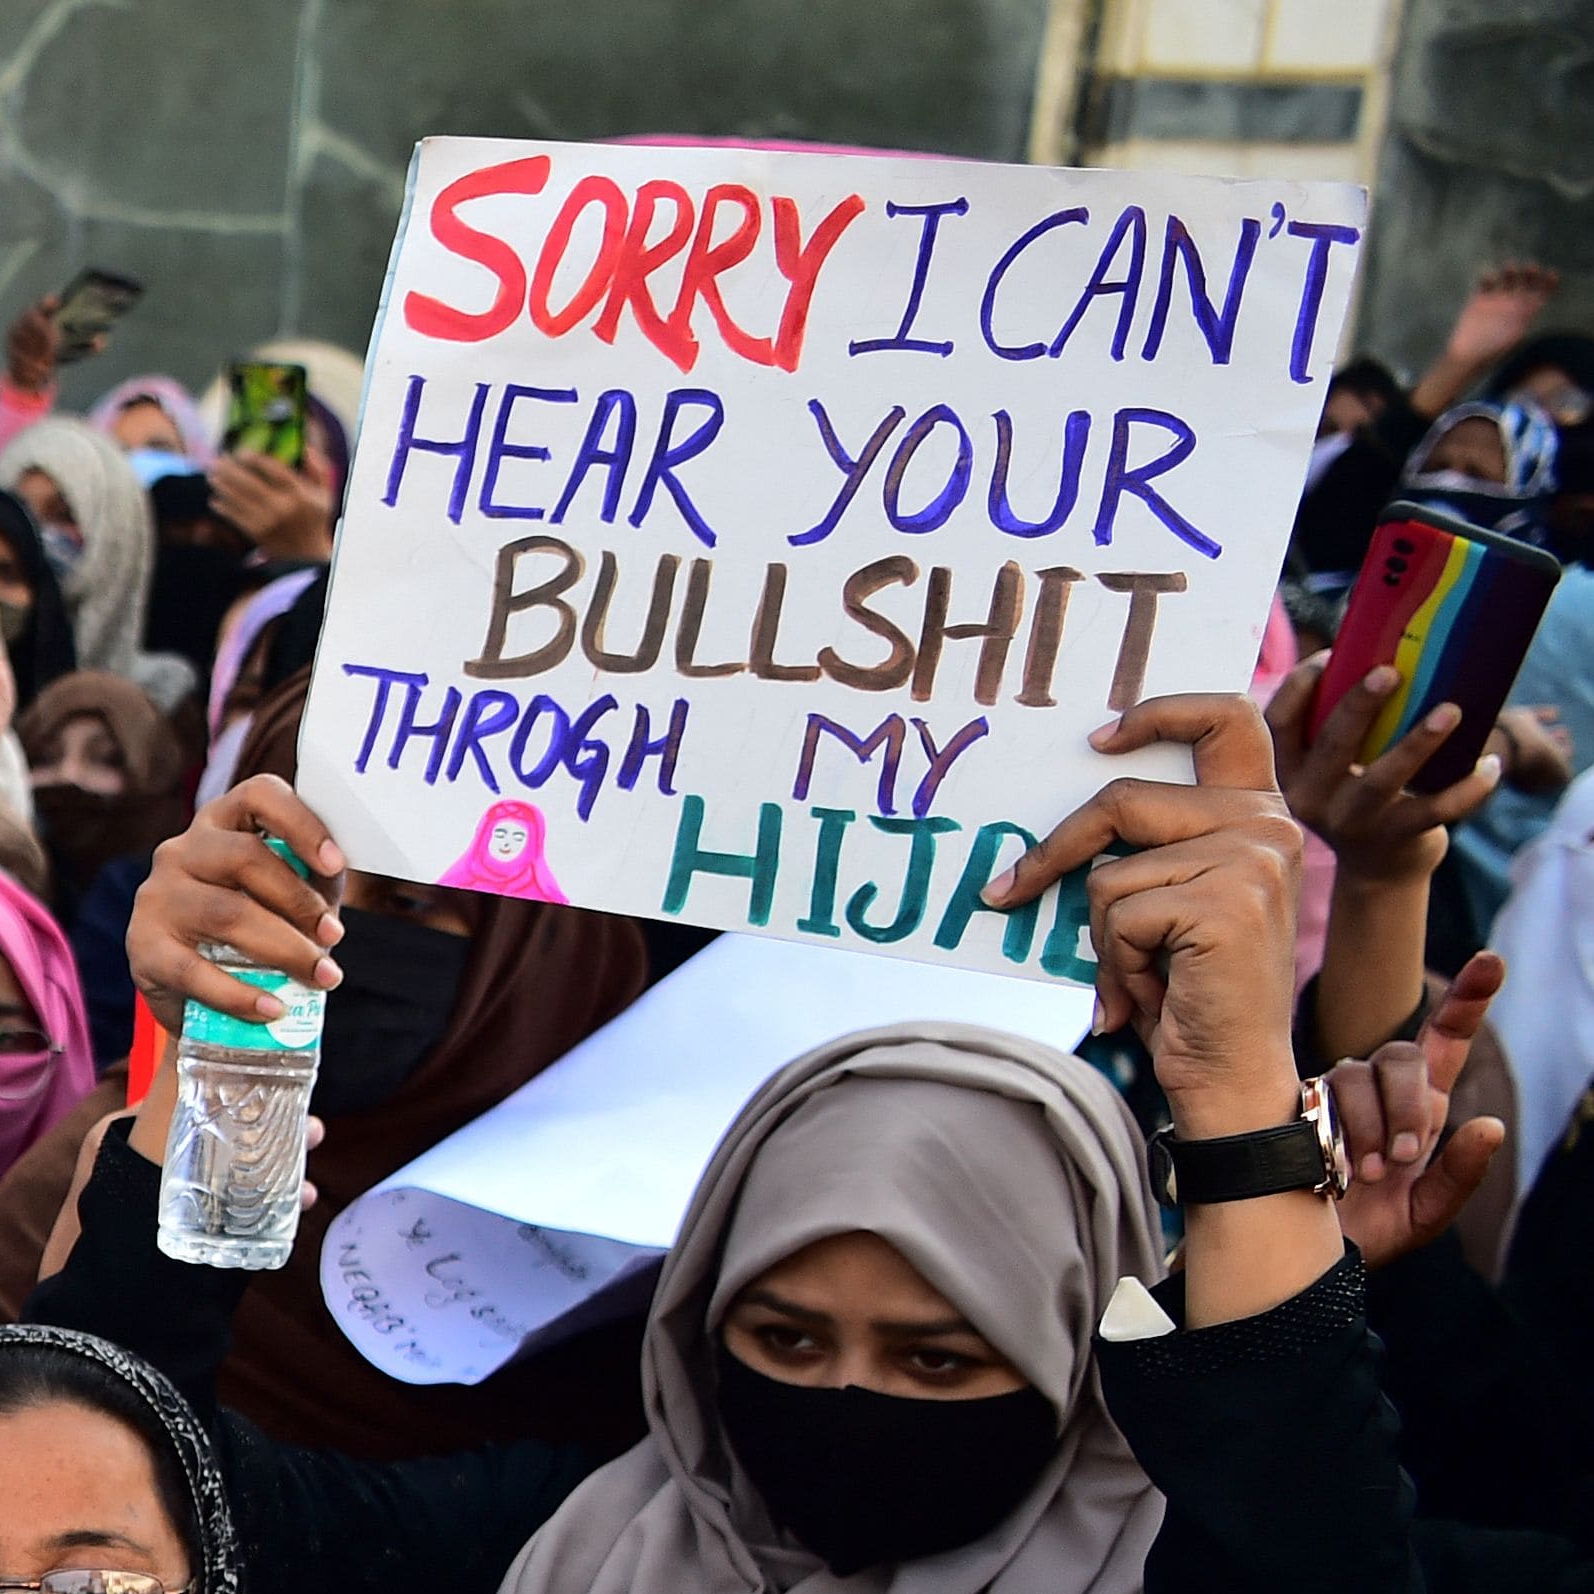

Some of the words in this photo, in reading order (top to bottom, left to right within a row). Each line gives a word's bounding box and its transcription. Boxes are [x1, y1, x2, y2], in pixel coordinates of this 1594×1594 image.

[404, 155, 865, 374] SORRY
[848, 198, 969, 358] I
[980, 201, 1360, 383] CAN'T
[379, 374, 723, 549] HEAR
[787, 399, 1222, 559] YOUR
[463, 534, 1187, 712] BULLSHIT
[341, 662, 689, 823] THROGH
[792, 712, 989, 819] MY
